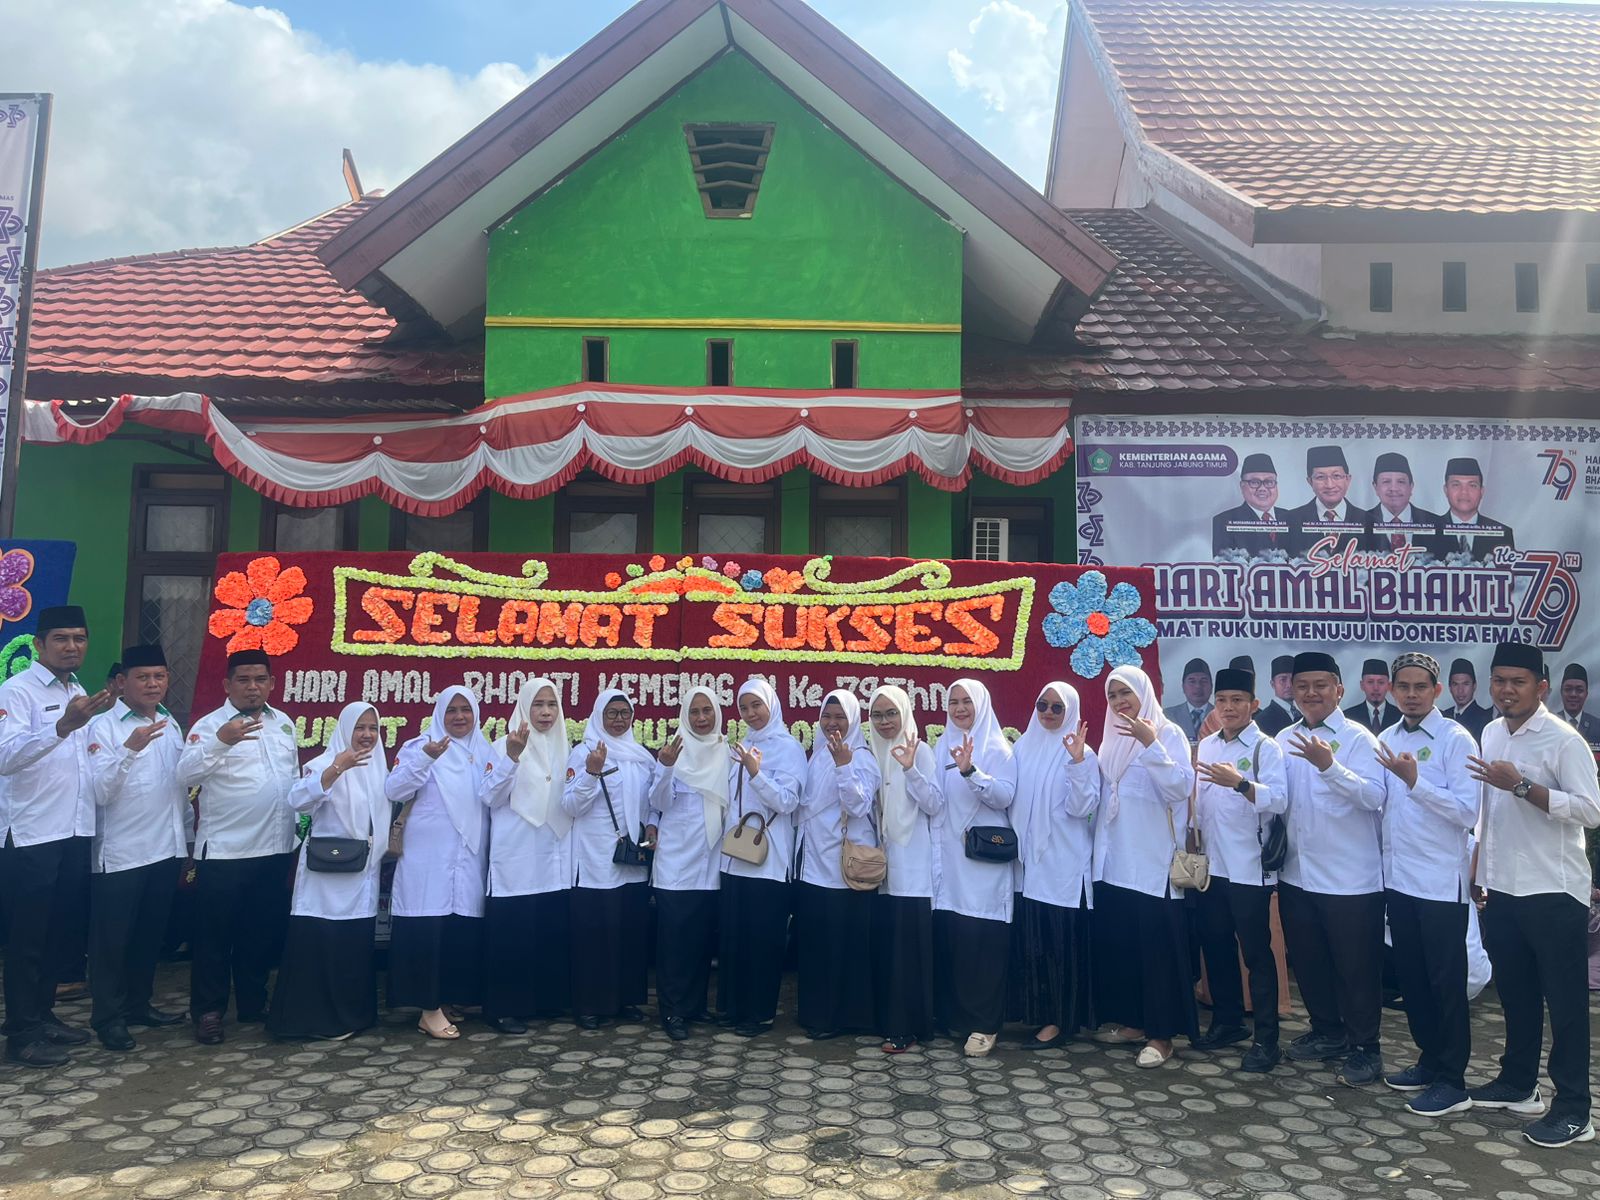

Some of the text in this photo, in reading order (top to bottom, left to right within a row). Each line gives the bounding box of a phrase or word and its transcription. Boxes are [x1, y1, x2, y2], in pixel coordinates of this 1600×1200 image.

[1119, 453, 1227, 461] KEMENTERIAN AGAMA
[1137, 461, 1172, 469] TANJUNG
[1173, 461, 1204, 469] JABUNG
[1537, 448, 1577, 501] 79
[1307, 537, 1426, 577] Selamat
[1565, 554, 1580, 568] TH
[1251, 568, 1363, 611] AMAL
[1373, 570, 1511, 614] BHAKTI
[352, 587, 1004, 655] SELAMAT SUKSES
[1208, 621, 1279, 639] RUKUN
[1282, 622, 1366, 640] MENUJU
[1370, 624, 1478, 642] INDONESIA
[1482, 627, 1532, 644] EMAS
[283, 670, 347, 703] HARI
[362, 669, 440, 704] AMAL
[463, 670, 580, 706] BHATI
[788, 675, 824, 708] Ke
